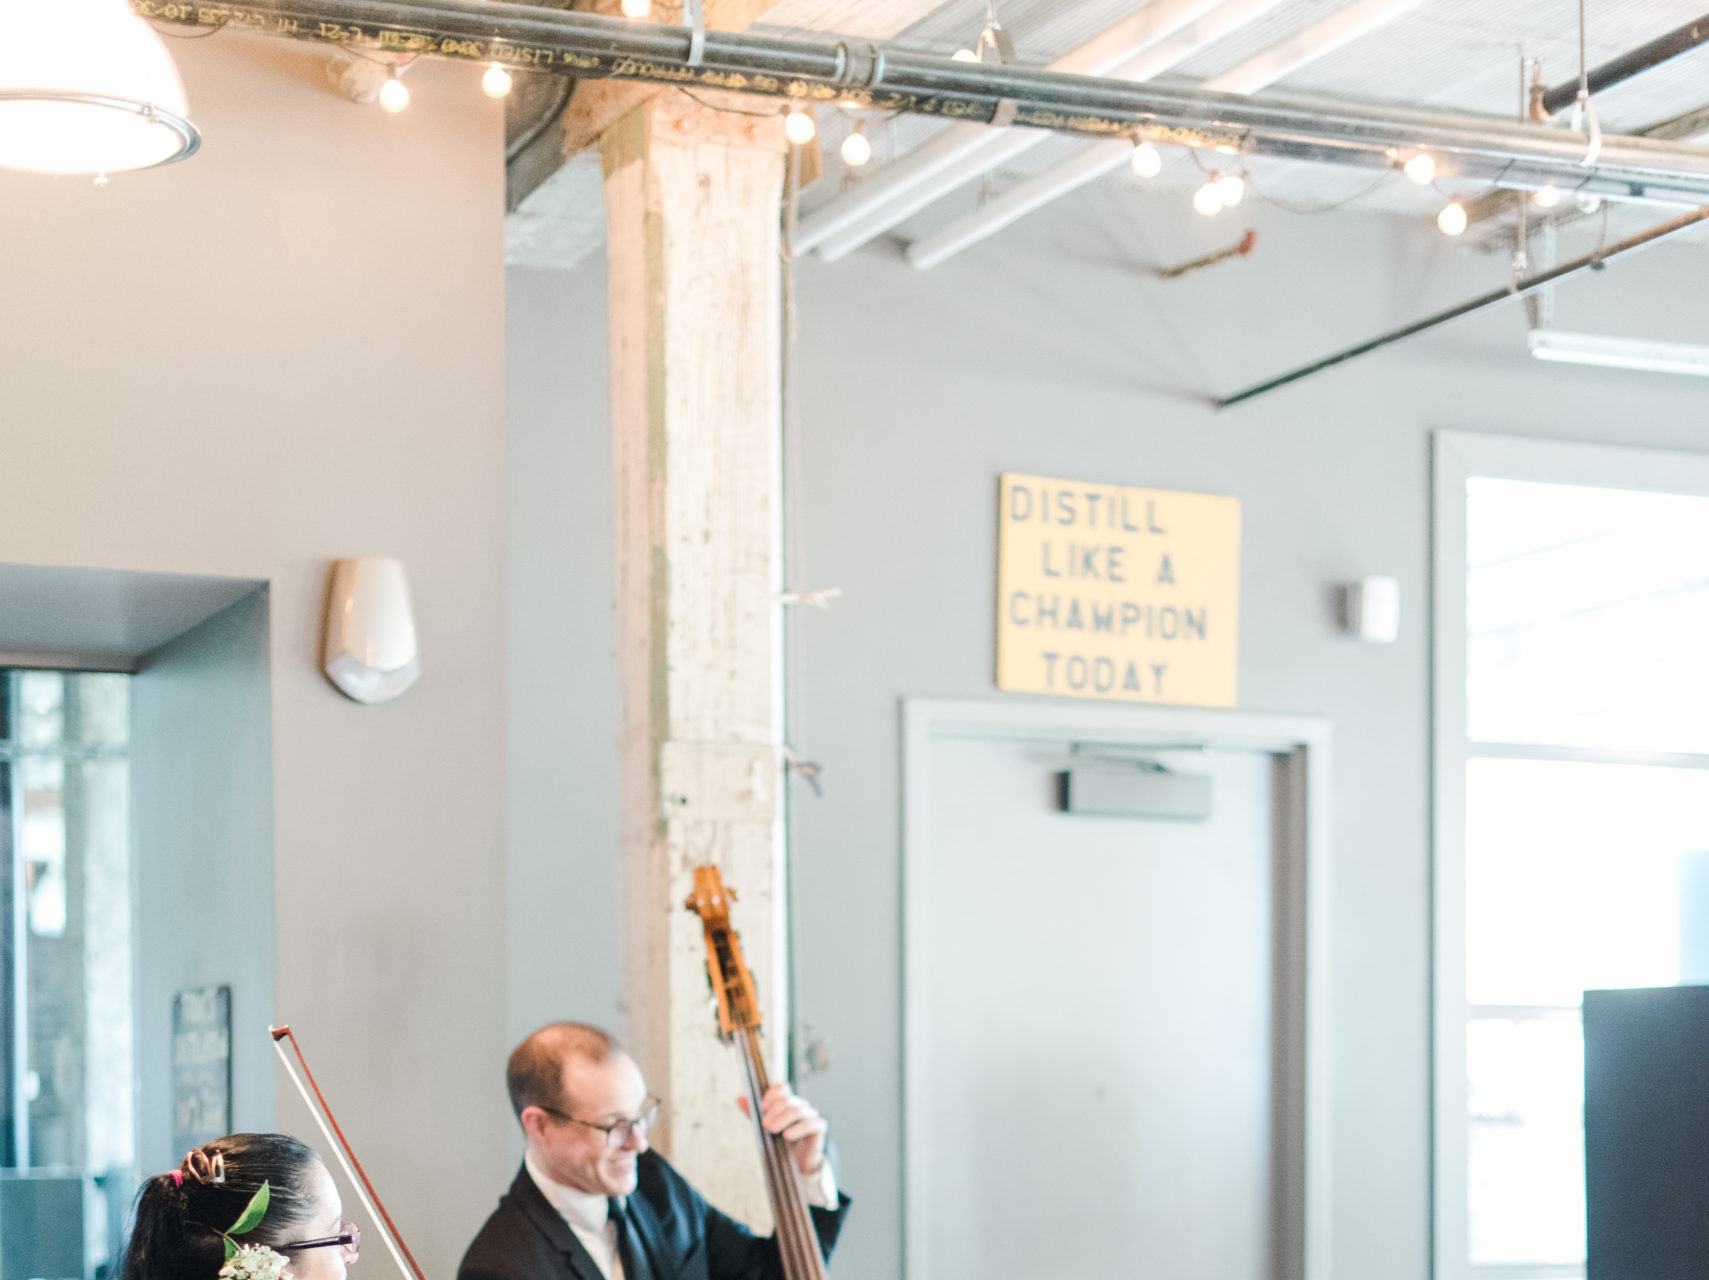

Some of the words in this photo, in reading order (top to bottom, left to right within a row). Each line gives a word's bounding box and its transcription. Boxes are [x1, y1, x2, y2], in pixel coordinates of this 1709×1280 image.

[1010, 485, 1167, 534] DISTILL
[1042, 541, 1126, 584] LIKE
[1156, 553, 1177, 586] A
[1009, 591, 1207, 642] CHAMPION
[1041, 652, 1170, 696] TODAY
